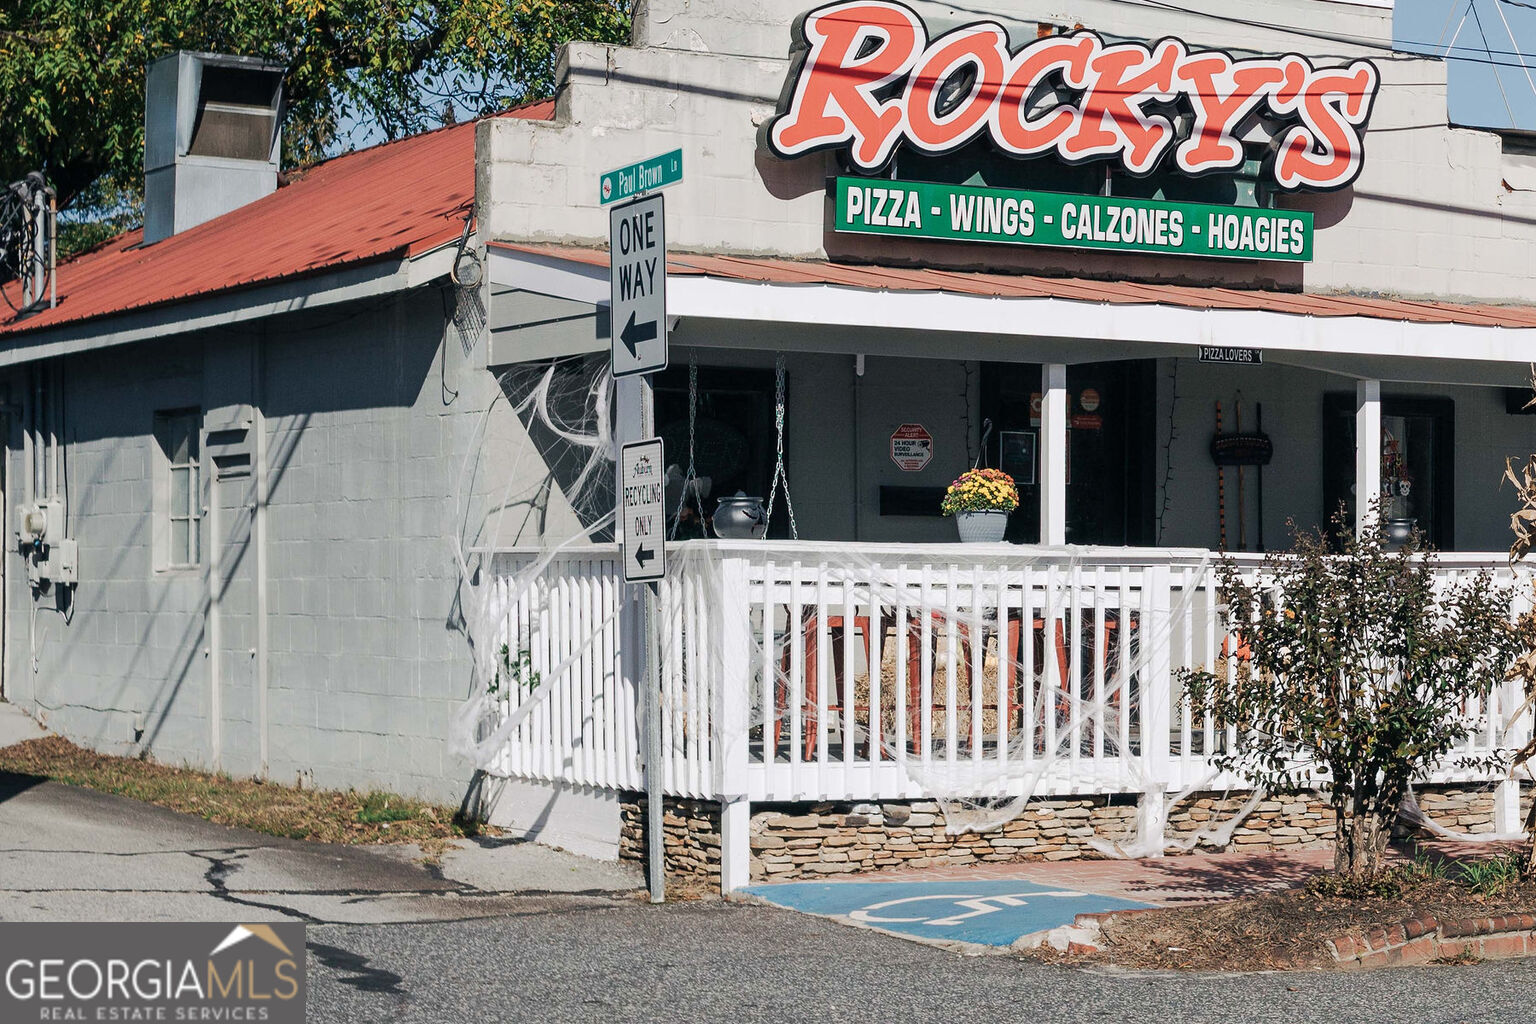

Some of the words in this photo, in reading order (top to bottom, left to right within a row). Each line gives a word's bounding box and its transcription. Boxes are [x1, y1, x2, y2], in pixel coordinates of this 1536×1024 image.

[771, 0, 1379, 189] ROCKY'S
[618, 171, 636, 196] Paul
[638, 163, 663, 190] Brown
[670, 157, 678, 173] Ln
[619, 210, 656, 256] ONE
[846, 186, 923, 230] PIZZA
[950, 193, 1036, 237] WINGS
[1061, 203, 1185, 247] CALZONES
[1207, 212, 1304, 255] HOAGIES
[618, 257, 658, 302] WAY
[1204, 348, 1224, 360] PIZZA
[1225, 349, 1252, 361] LOVERS
[625, 483, 660, 507] RECYCLING
[635, 516, 653, 536] ONLY
